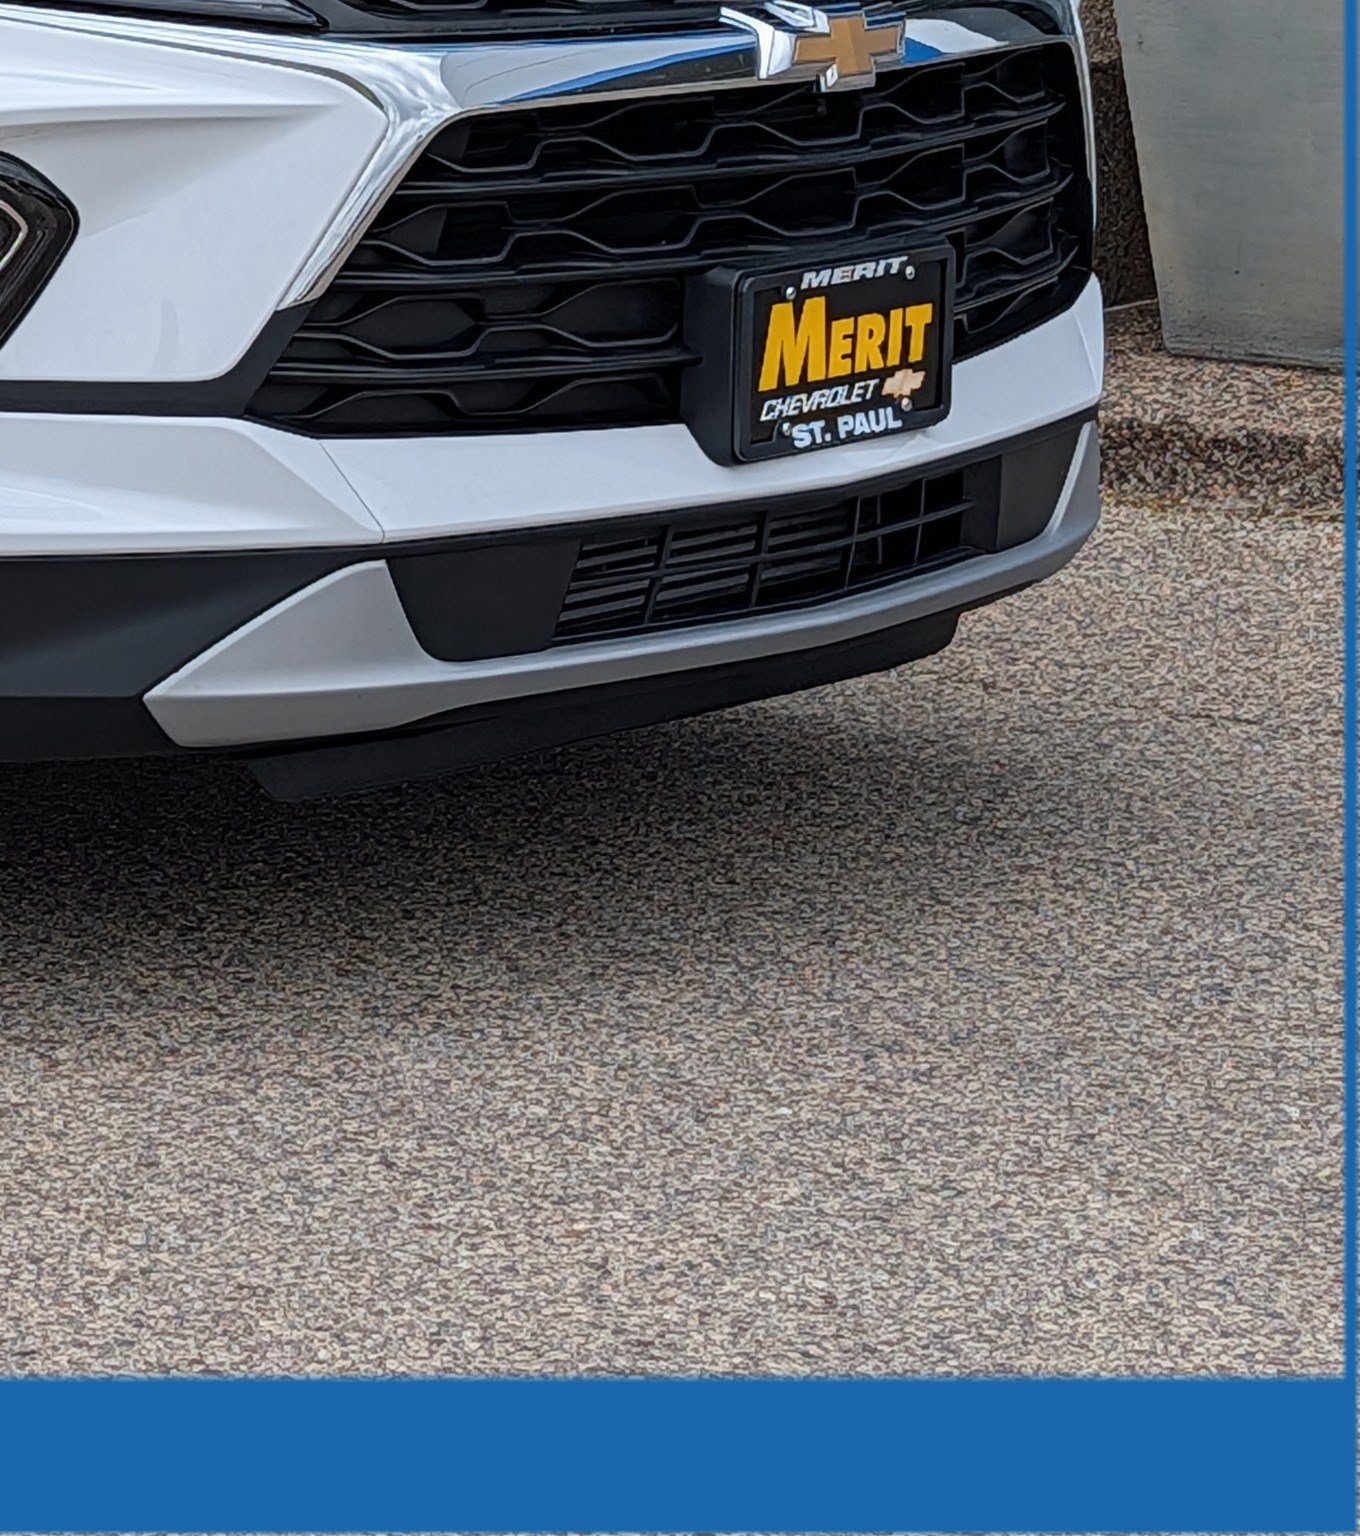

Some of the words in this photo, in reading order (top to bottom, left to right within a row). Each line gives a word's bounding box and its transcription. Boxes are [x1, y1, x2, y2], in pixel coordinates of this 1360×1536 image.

[800, 256, 909, 290] MERIT
[758, 295, 933, 392] MERIT
[760, 378, 880, 422] CHEVROLET
[792, 420, 832, 449] ST.
[837, 406, 903, 439] PAUL
